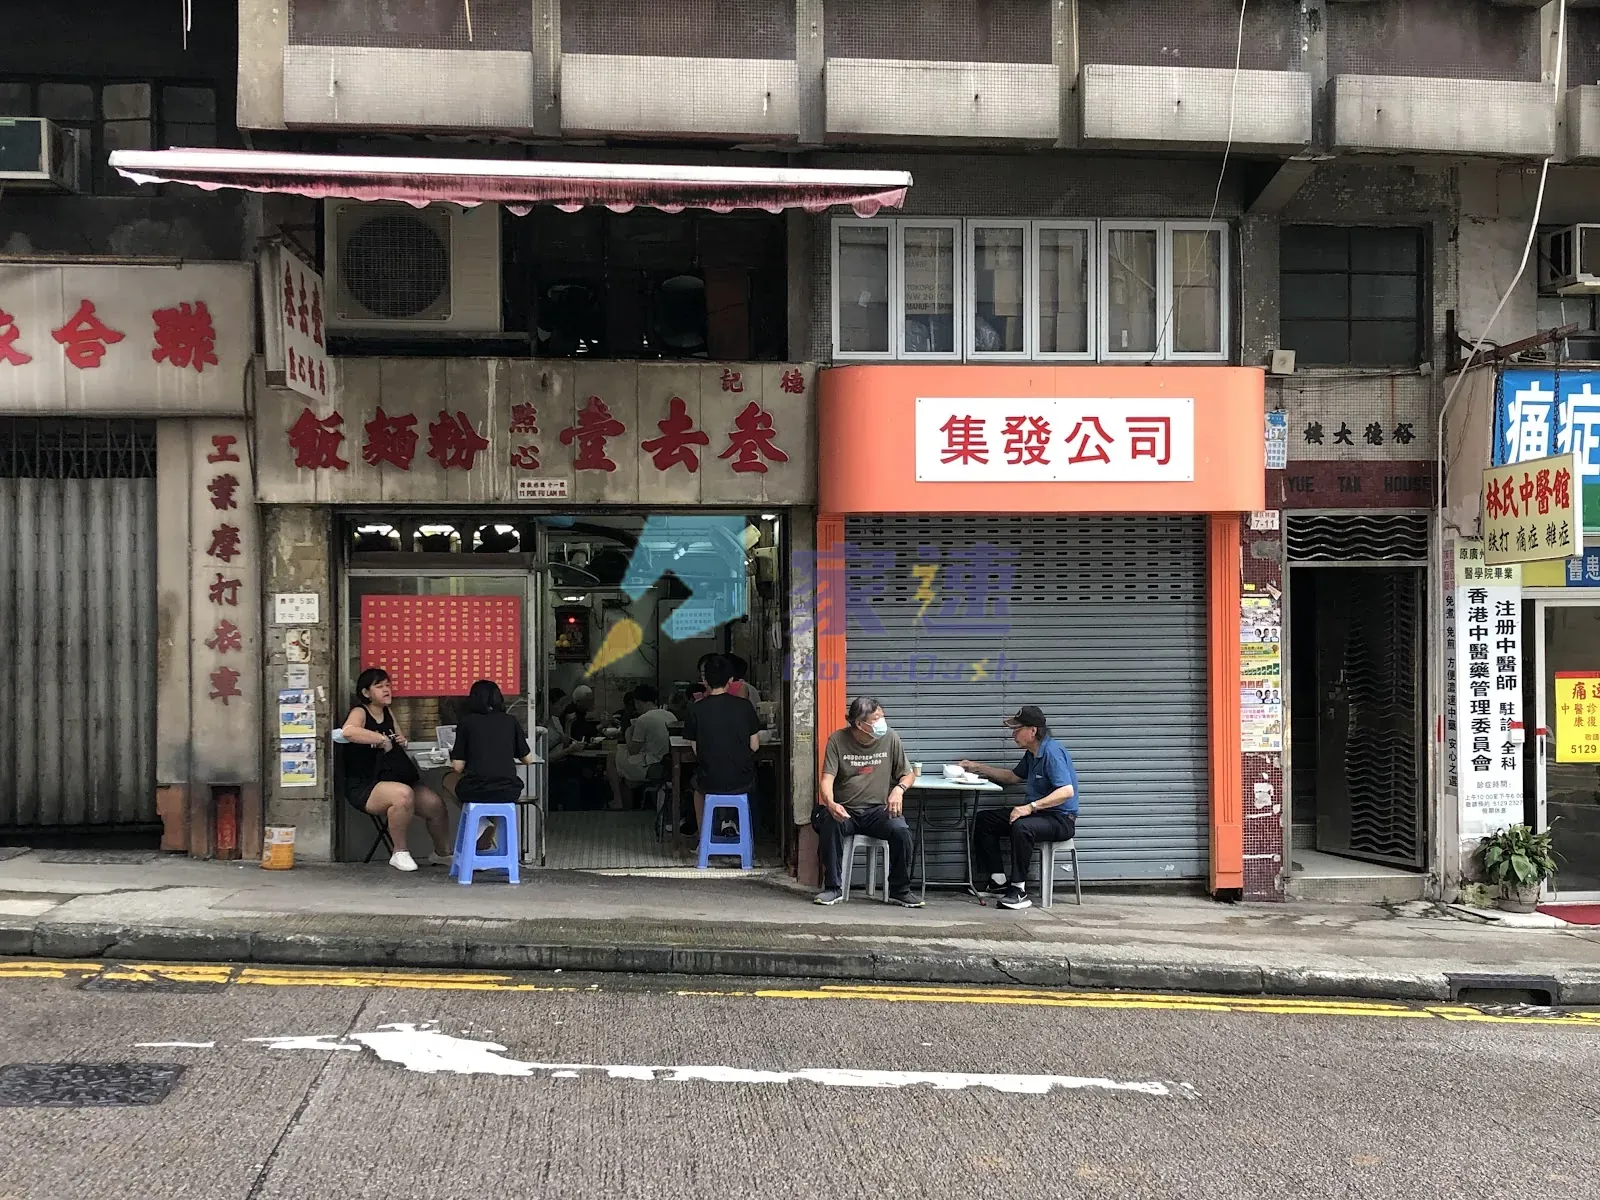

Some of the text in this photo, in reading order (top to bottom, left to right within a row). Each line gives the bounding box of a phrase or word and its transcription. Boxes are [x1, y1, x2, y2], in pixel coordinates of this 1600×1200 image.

[1506, 381, 1600, 475] 痛症
[940, 415, 1170, 465] 集發公司
[1288, 476, 1430, 492] YUE TAK HOUSE
[1486, 467, 1571, 520] 林氏中醫館
[1255, 520, 1274, 528] 7-11
[1516, 524, 1539, 552] 痛症
[1464, 567, 1513, 580] 醫學院畢業
[1467, 587, 1492, 773] 香港中醫藥管理委員會
[1561, 703, 1598, 715] 中醫診
[1574, 716, 1598, 727] 康復
[1500, 741, 1516, 771] 全科
[1571, 744, 1597, 753] 5129
